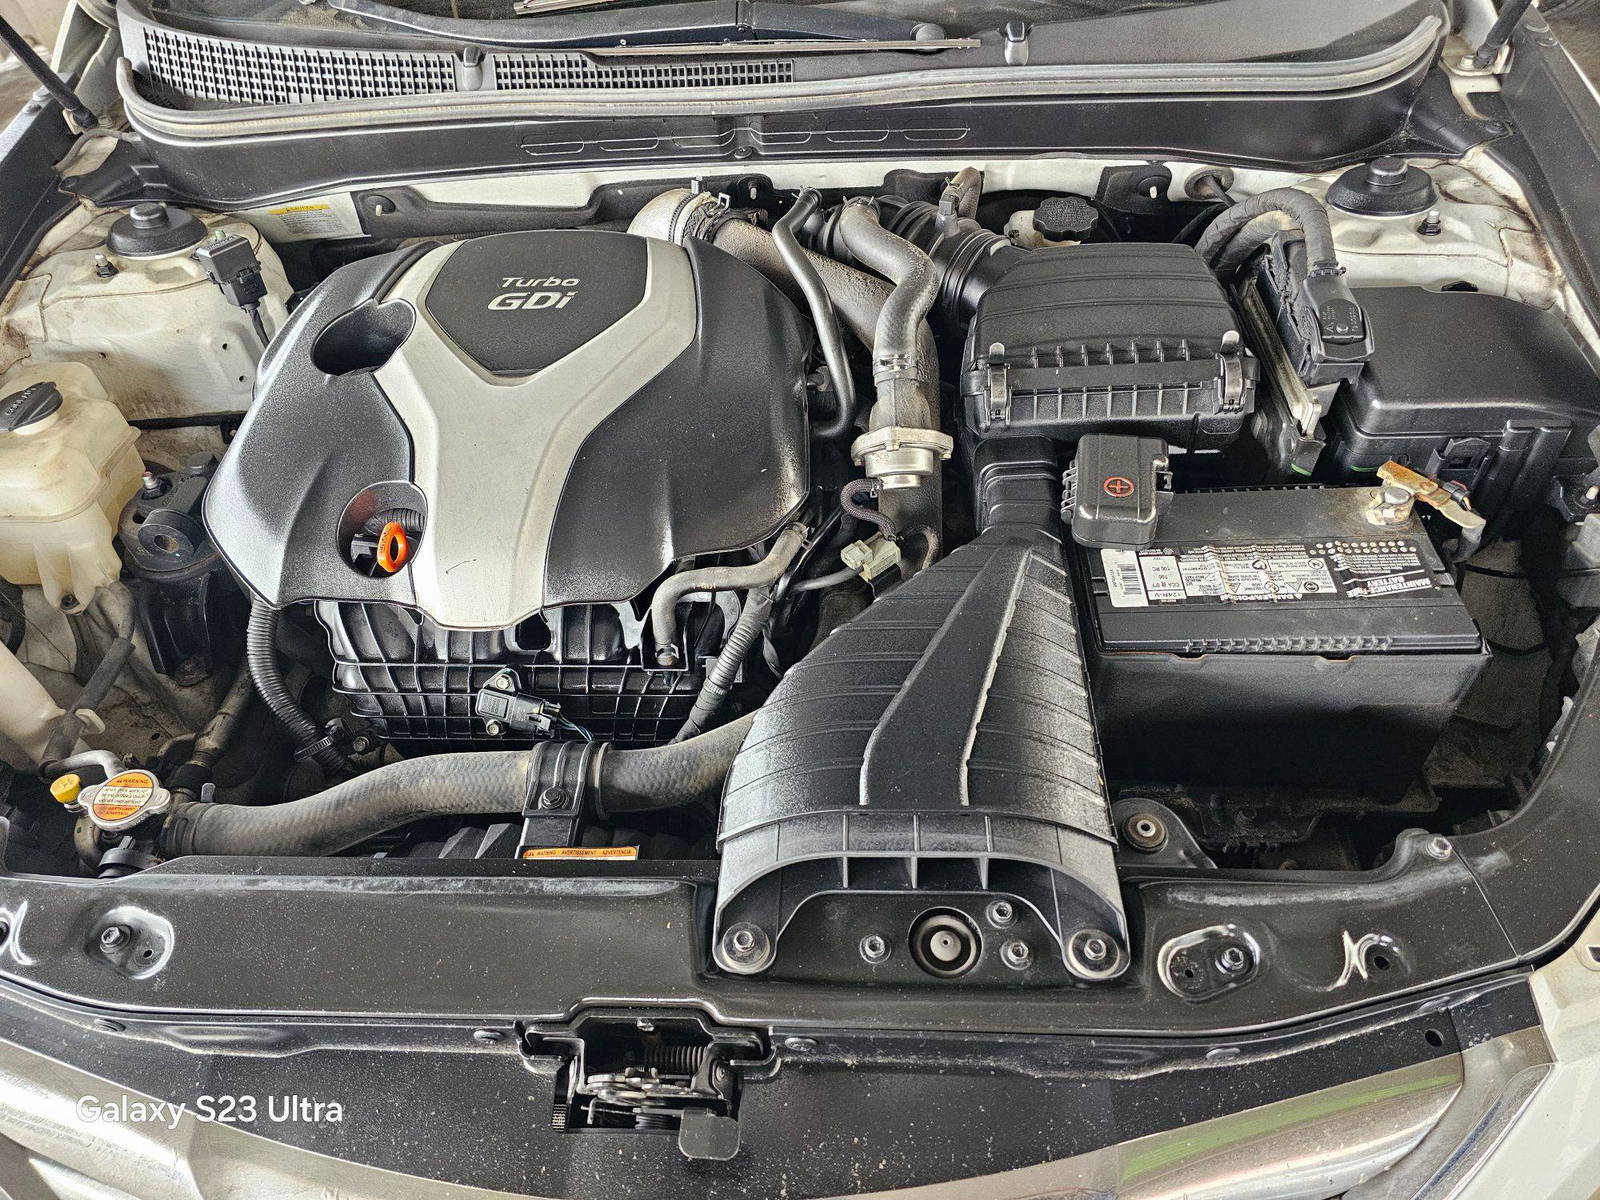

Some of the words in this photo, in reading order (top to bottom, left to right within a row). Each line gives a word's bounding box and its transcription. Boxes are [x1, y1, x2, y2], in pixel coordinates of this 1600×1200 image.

[502, 276, 580, 288] Turbo
[487, 291, 579, 311] GDi
[1366, 576, 1405, 588] BATTERY
